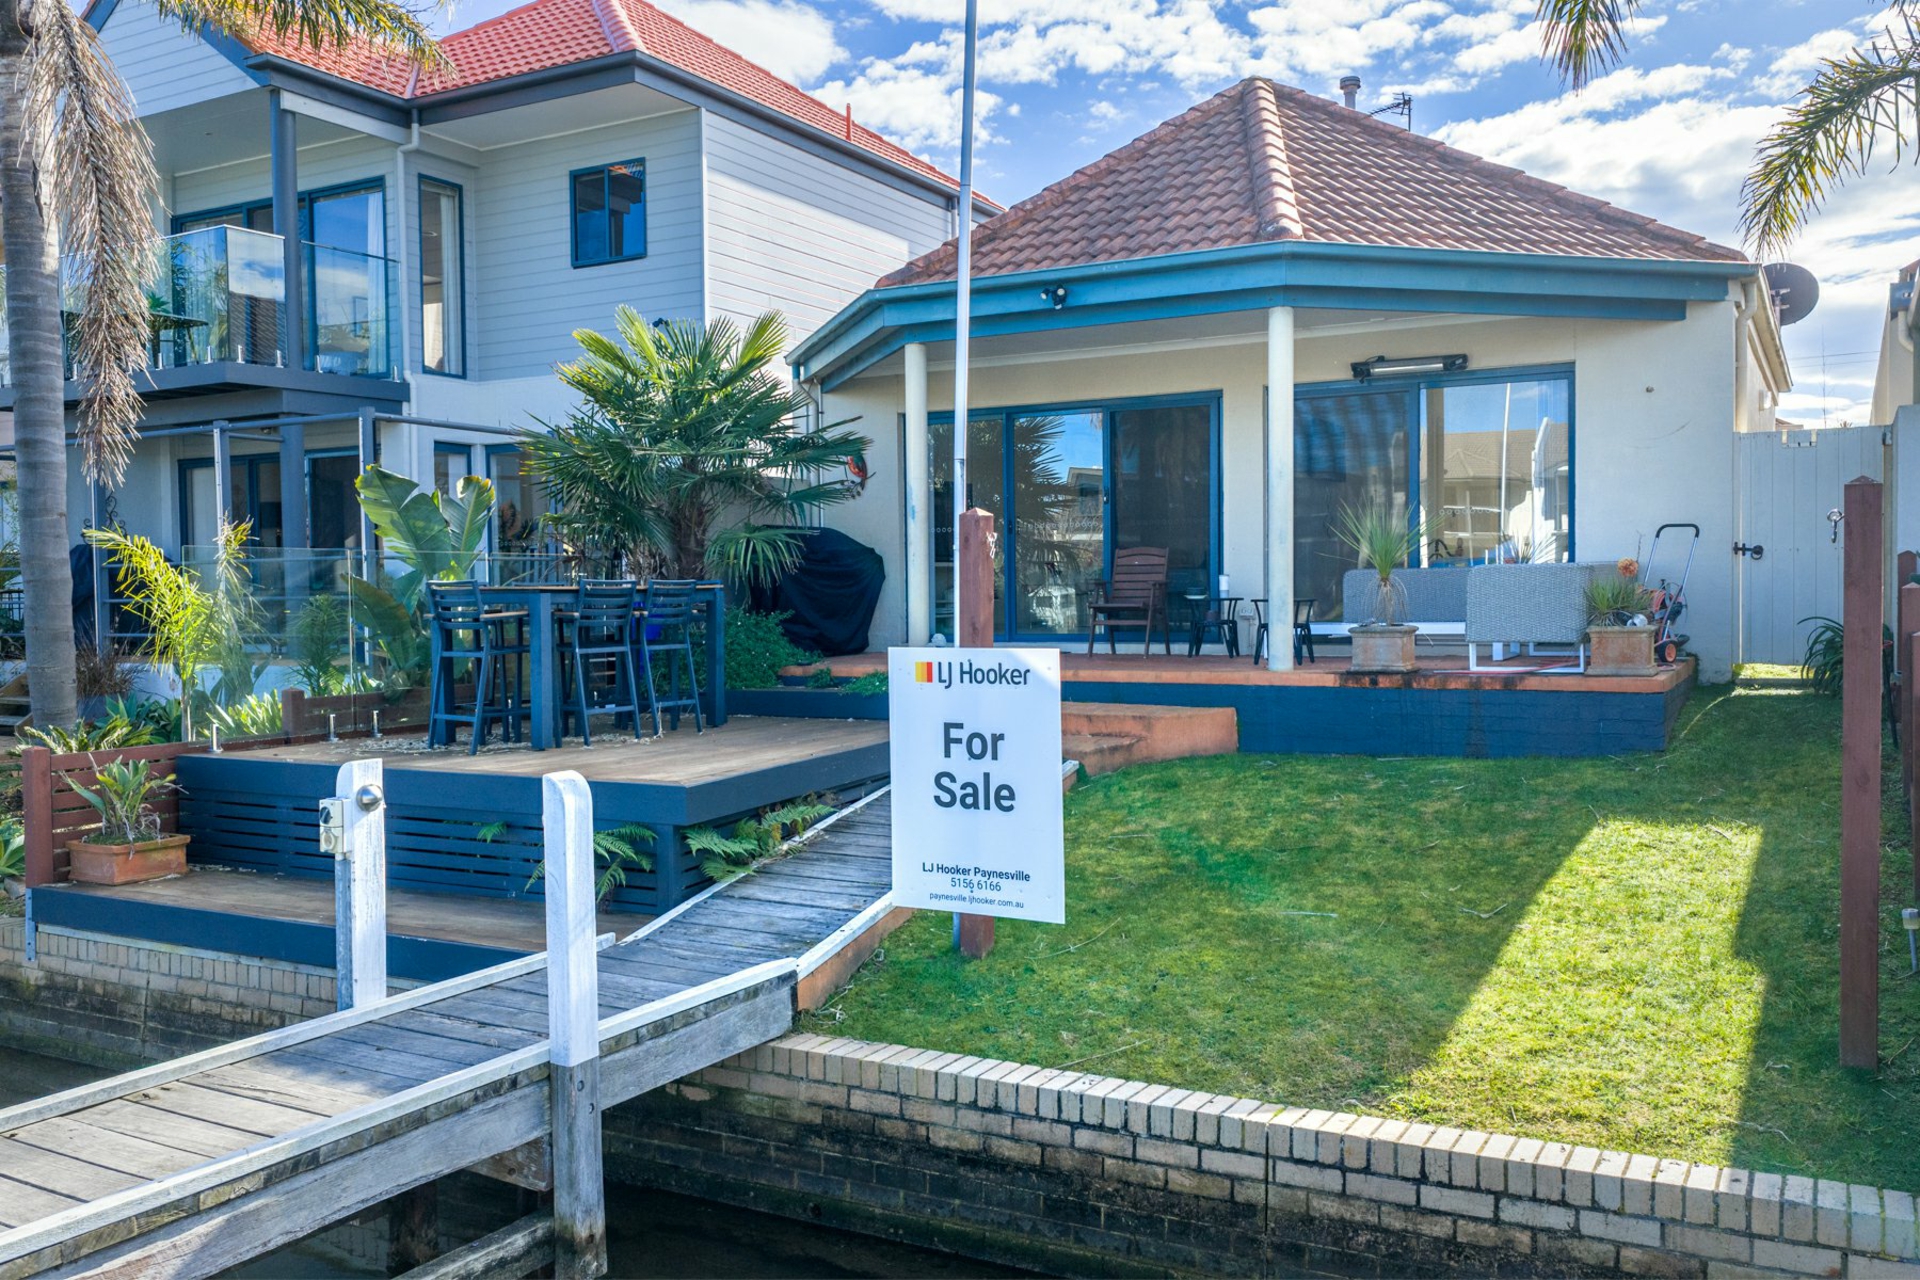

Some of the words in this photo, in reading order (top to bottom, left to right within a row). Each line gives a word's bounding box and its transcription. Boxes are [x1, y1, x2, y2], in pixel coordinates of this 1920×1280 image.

[938, 661, 952, 689] LJ
[960, 661, 1030, 685] Hooker
[943, 722, 1005, 761] For
[933, 771, 1016, 812] Sale
[922, 862, 934, 873] LJ
[936, 863, 971, 877] Hooker
[974, 866, 1031, 882] Paynesville
[950, 877, 975, 889] 5156
[976, 880, 1002, 892] 6166
[929, 892, 1024, 909] paynesville.ljhooker.com.au
